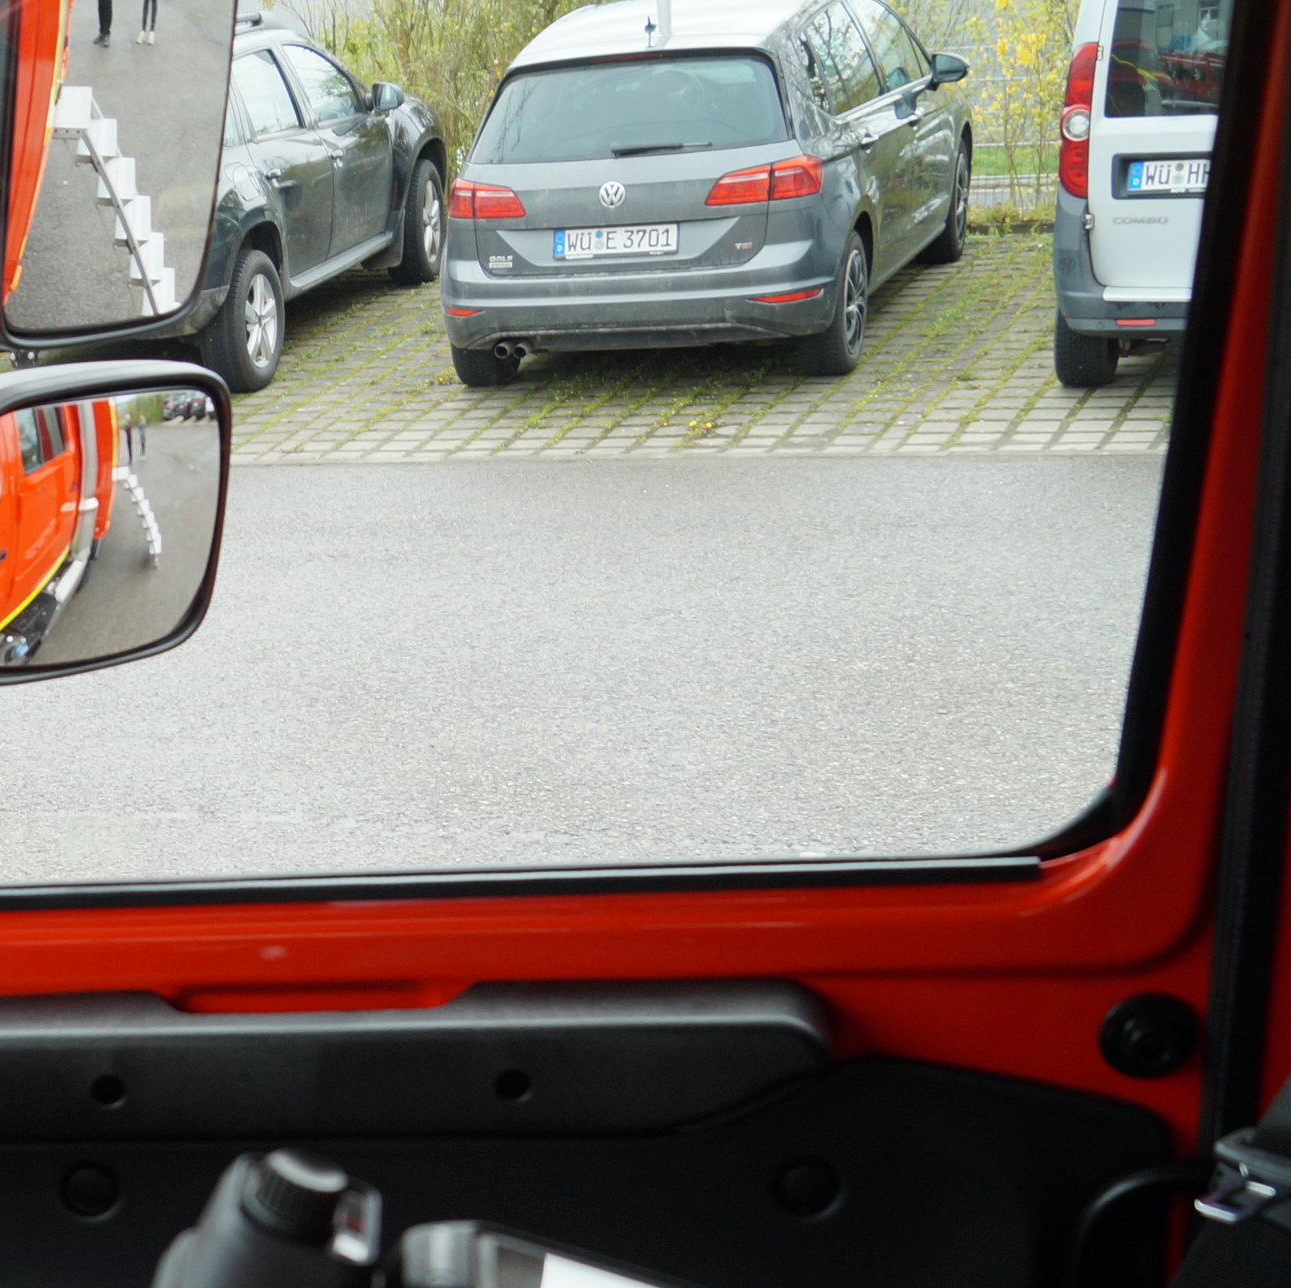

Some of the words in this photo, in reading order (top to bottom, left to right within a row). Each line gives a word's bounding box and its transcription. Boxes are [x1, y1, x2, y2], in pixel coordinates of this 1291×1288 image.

[1146, 164, 1171, 186] WÜ
[567, 231, 592, 252] WÜ
[605, 230, 617, 250] E
[623, 227, 672, 249] 3701
[489, 254, 514, 262] GOLF
